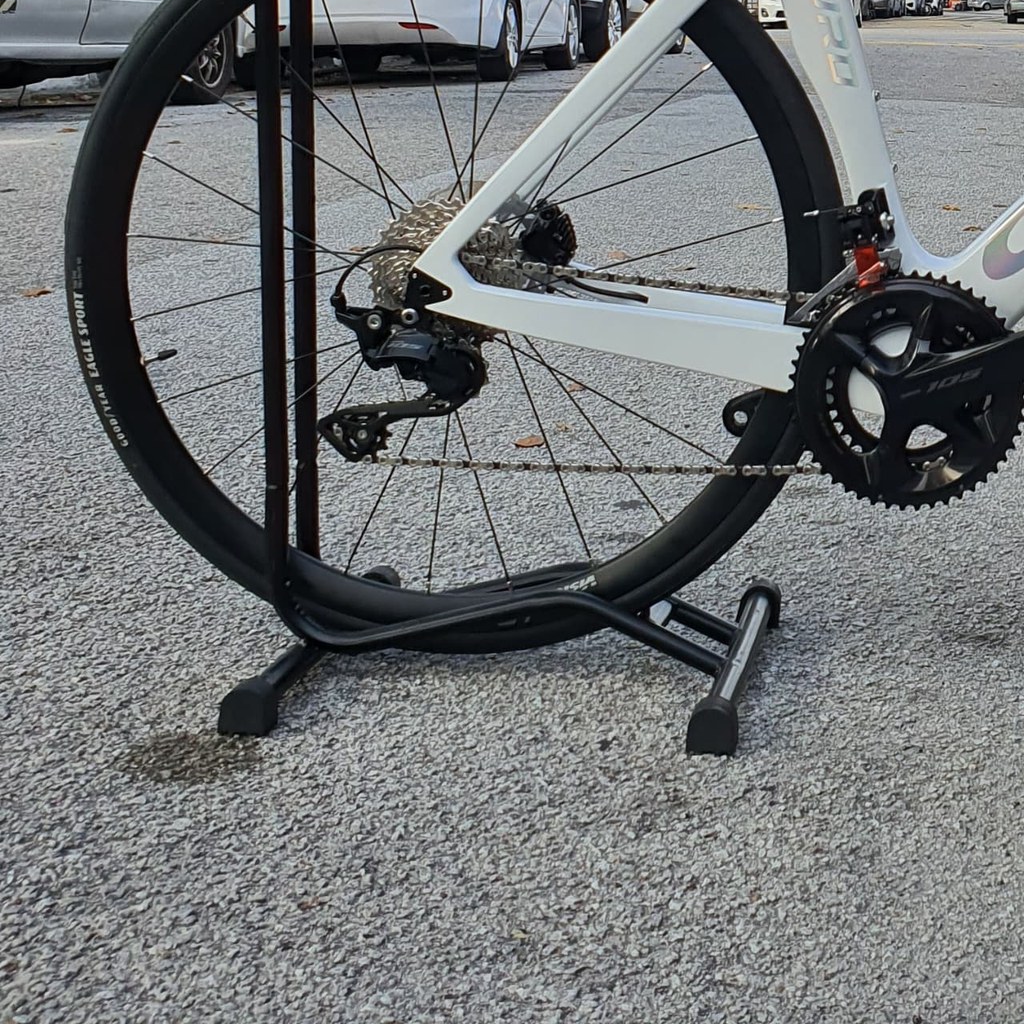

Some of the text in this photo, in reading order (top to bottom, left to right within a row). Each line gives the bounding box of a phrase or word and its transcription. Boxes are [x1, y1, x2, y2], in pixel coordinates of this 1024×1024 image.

[73, 292, 89, 337] SPORT
[80, 339, 100, 378] EAGLE
[94, 384, 129, 448] GOODYEAR
